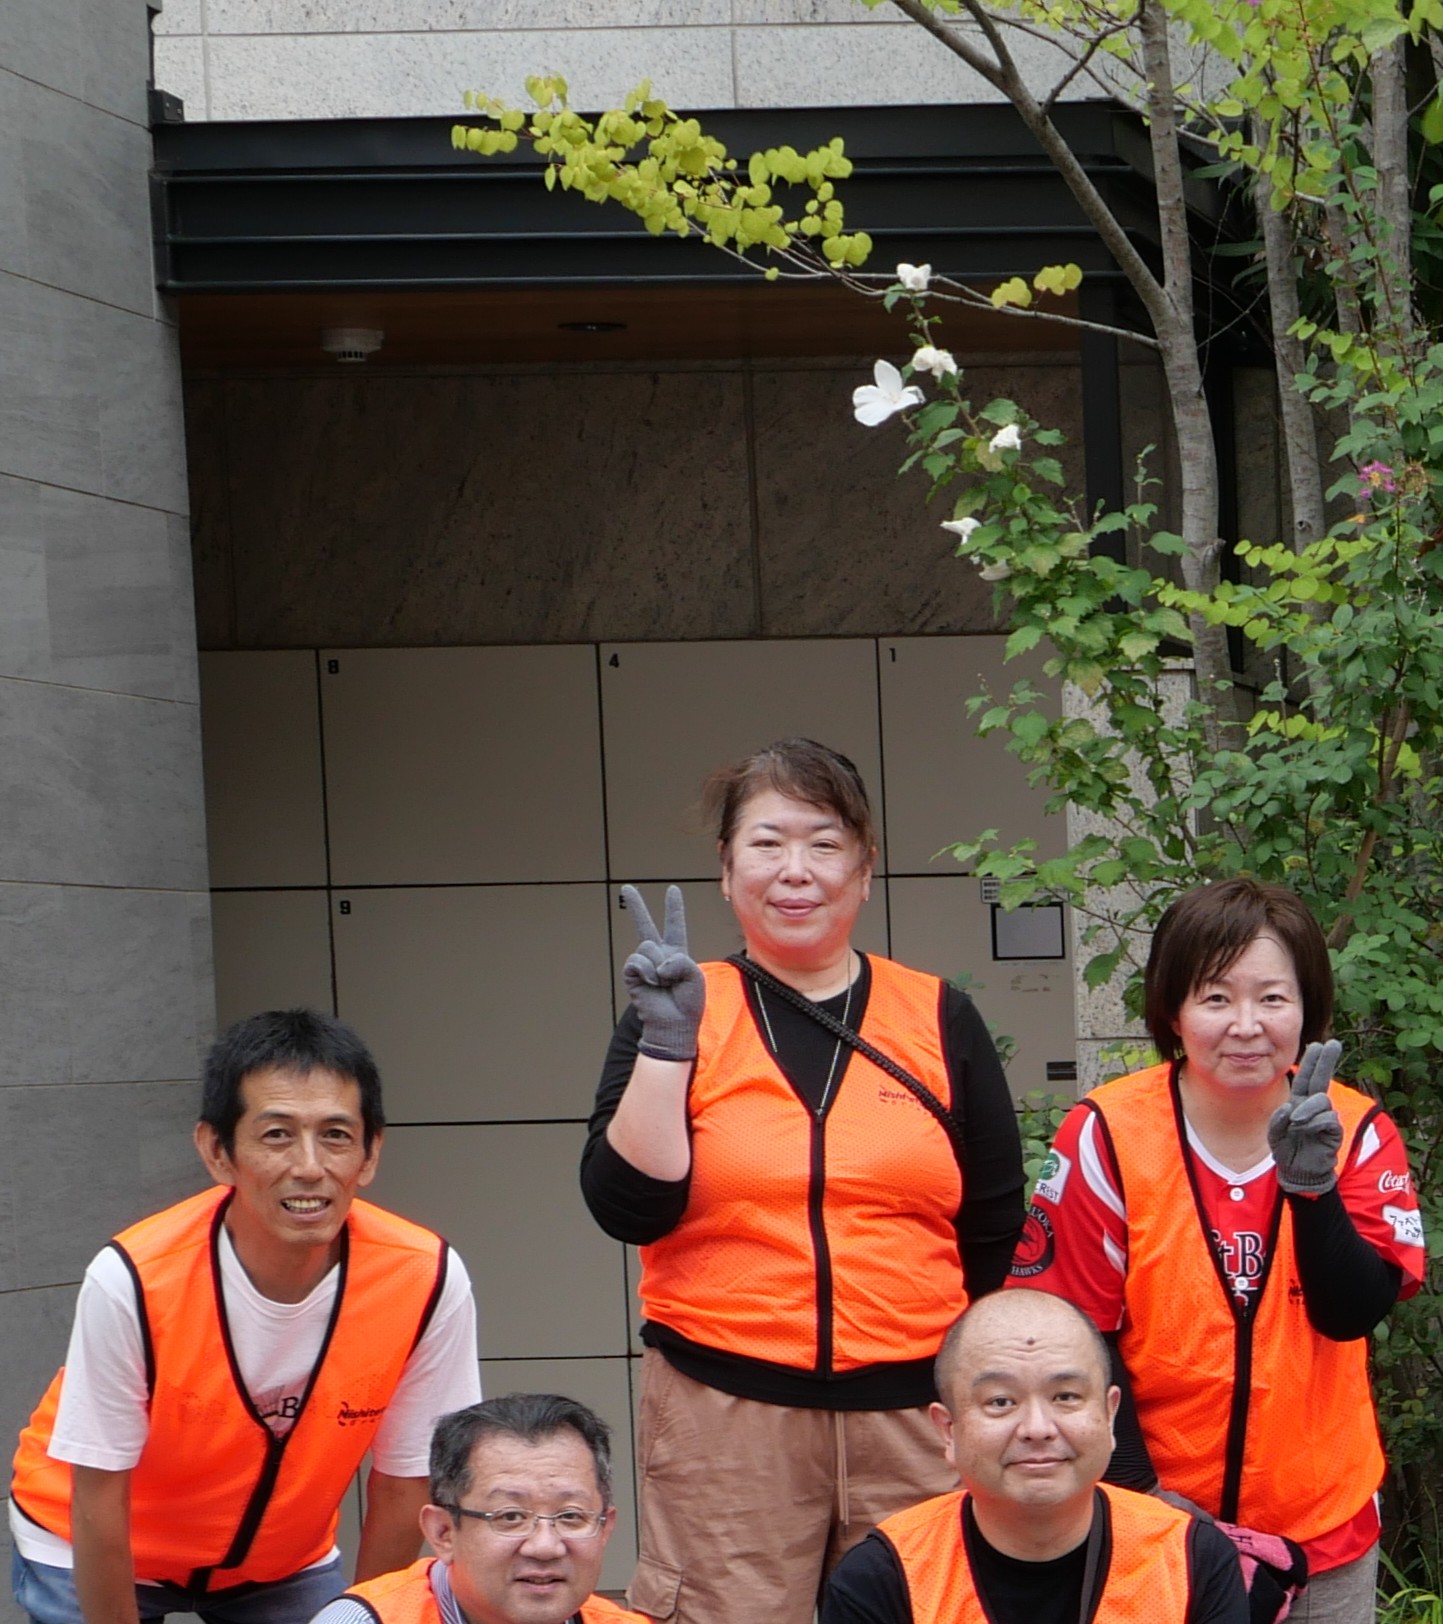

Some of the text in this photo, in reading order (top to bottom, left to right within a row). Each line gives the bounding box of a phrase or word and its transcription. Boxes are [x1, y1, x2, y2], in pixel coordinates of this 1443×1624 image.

[327, 659, 340, 675] 8
[608, 652, 620, 669] 4
[339, 900, 352, 915] 9
